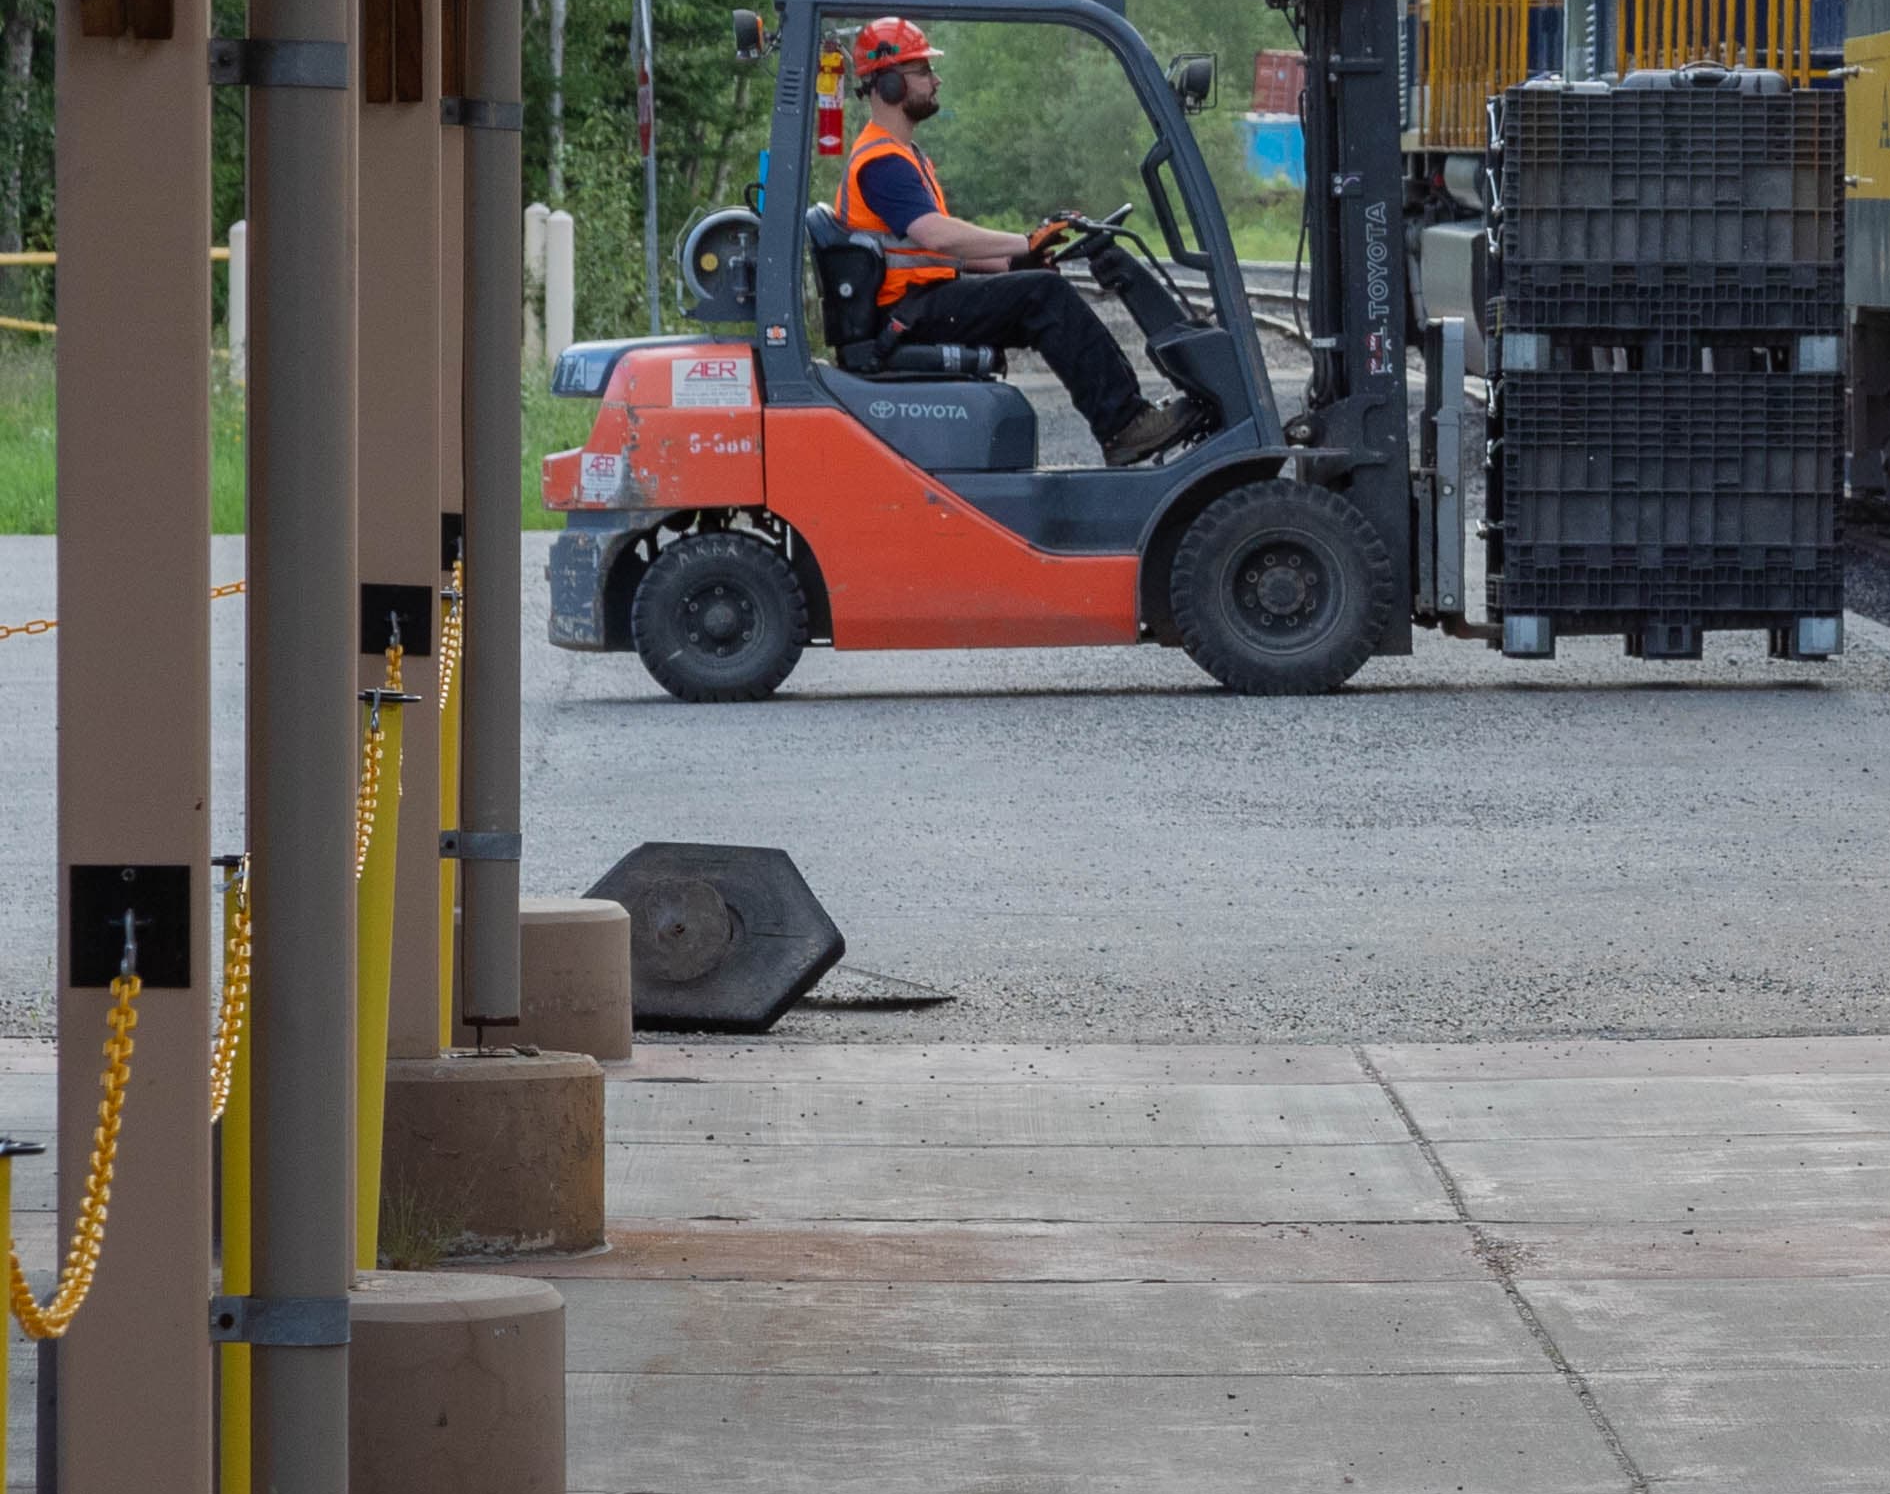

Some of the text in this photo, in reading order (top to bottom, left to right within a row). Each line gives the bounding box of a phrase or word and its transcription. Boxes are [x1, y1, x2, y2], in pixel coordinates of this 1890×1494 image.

[1365, 201, 1390, 319] TOYOTA
[686, 361, 737, 378] AER
[897, 403, 968, 419] TOYOTA
[589, 456, 616, 472] AER
